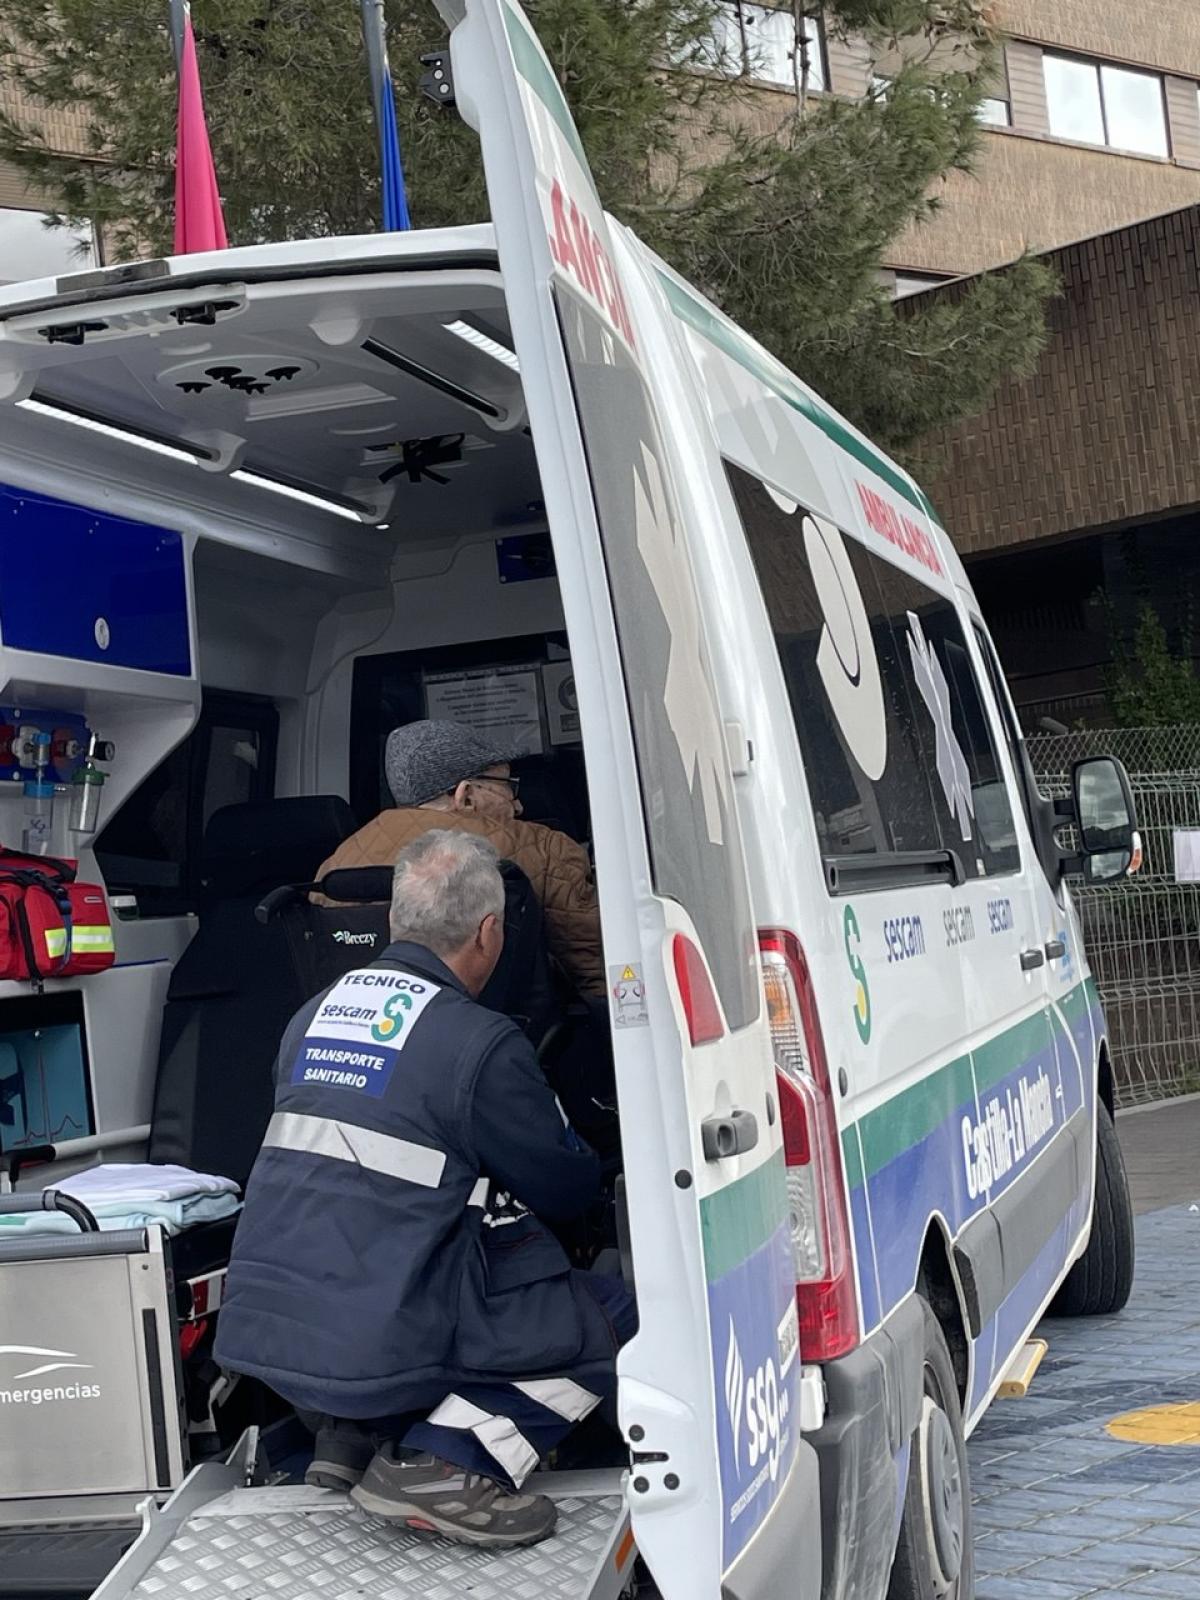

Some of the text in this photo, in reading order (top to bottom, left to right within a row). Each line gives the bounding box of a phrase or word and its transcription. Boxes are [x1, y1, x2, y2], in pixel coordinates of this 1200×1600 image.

[344, 930, 376, 947] Breezy
[884, 915, 926, 963] sescam
[344, 974, 426, 994] TECNICO
[320, 1003, 377, 1021] sescam
[305, 1047, 385, 1071] TRANSPORTE
[303, 1067, 367, 1088] SANITARIO
[746, 1357, 780, 1481] ssg
